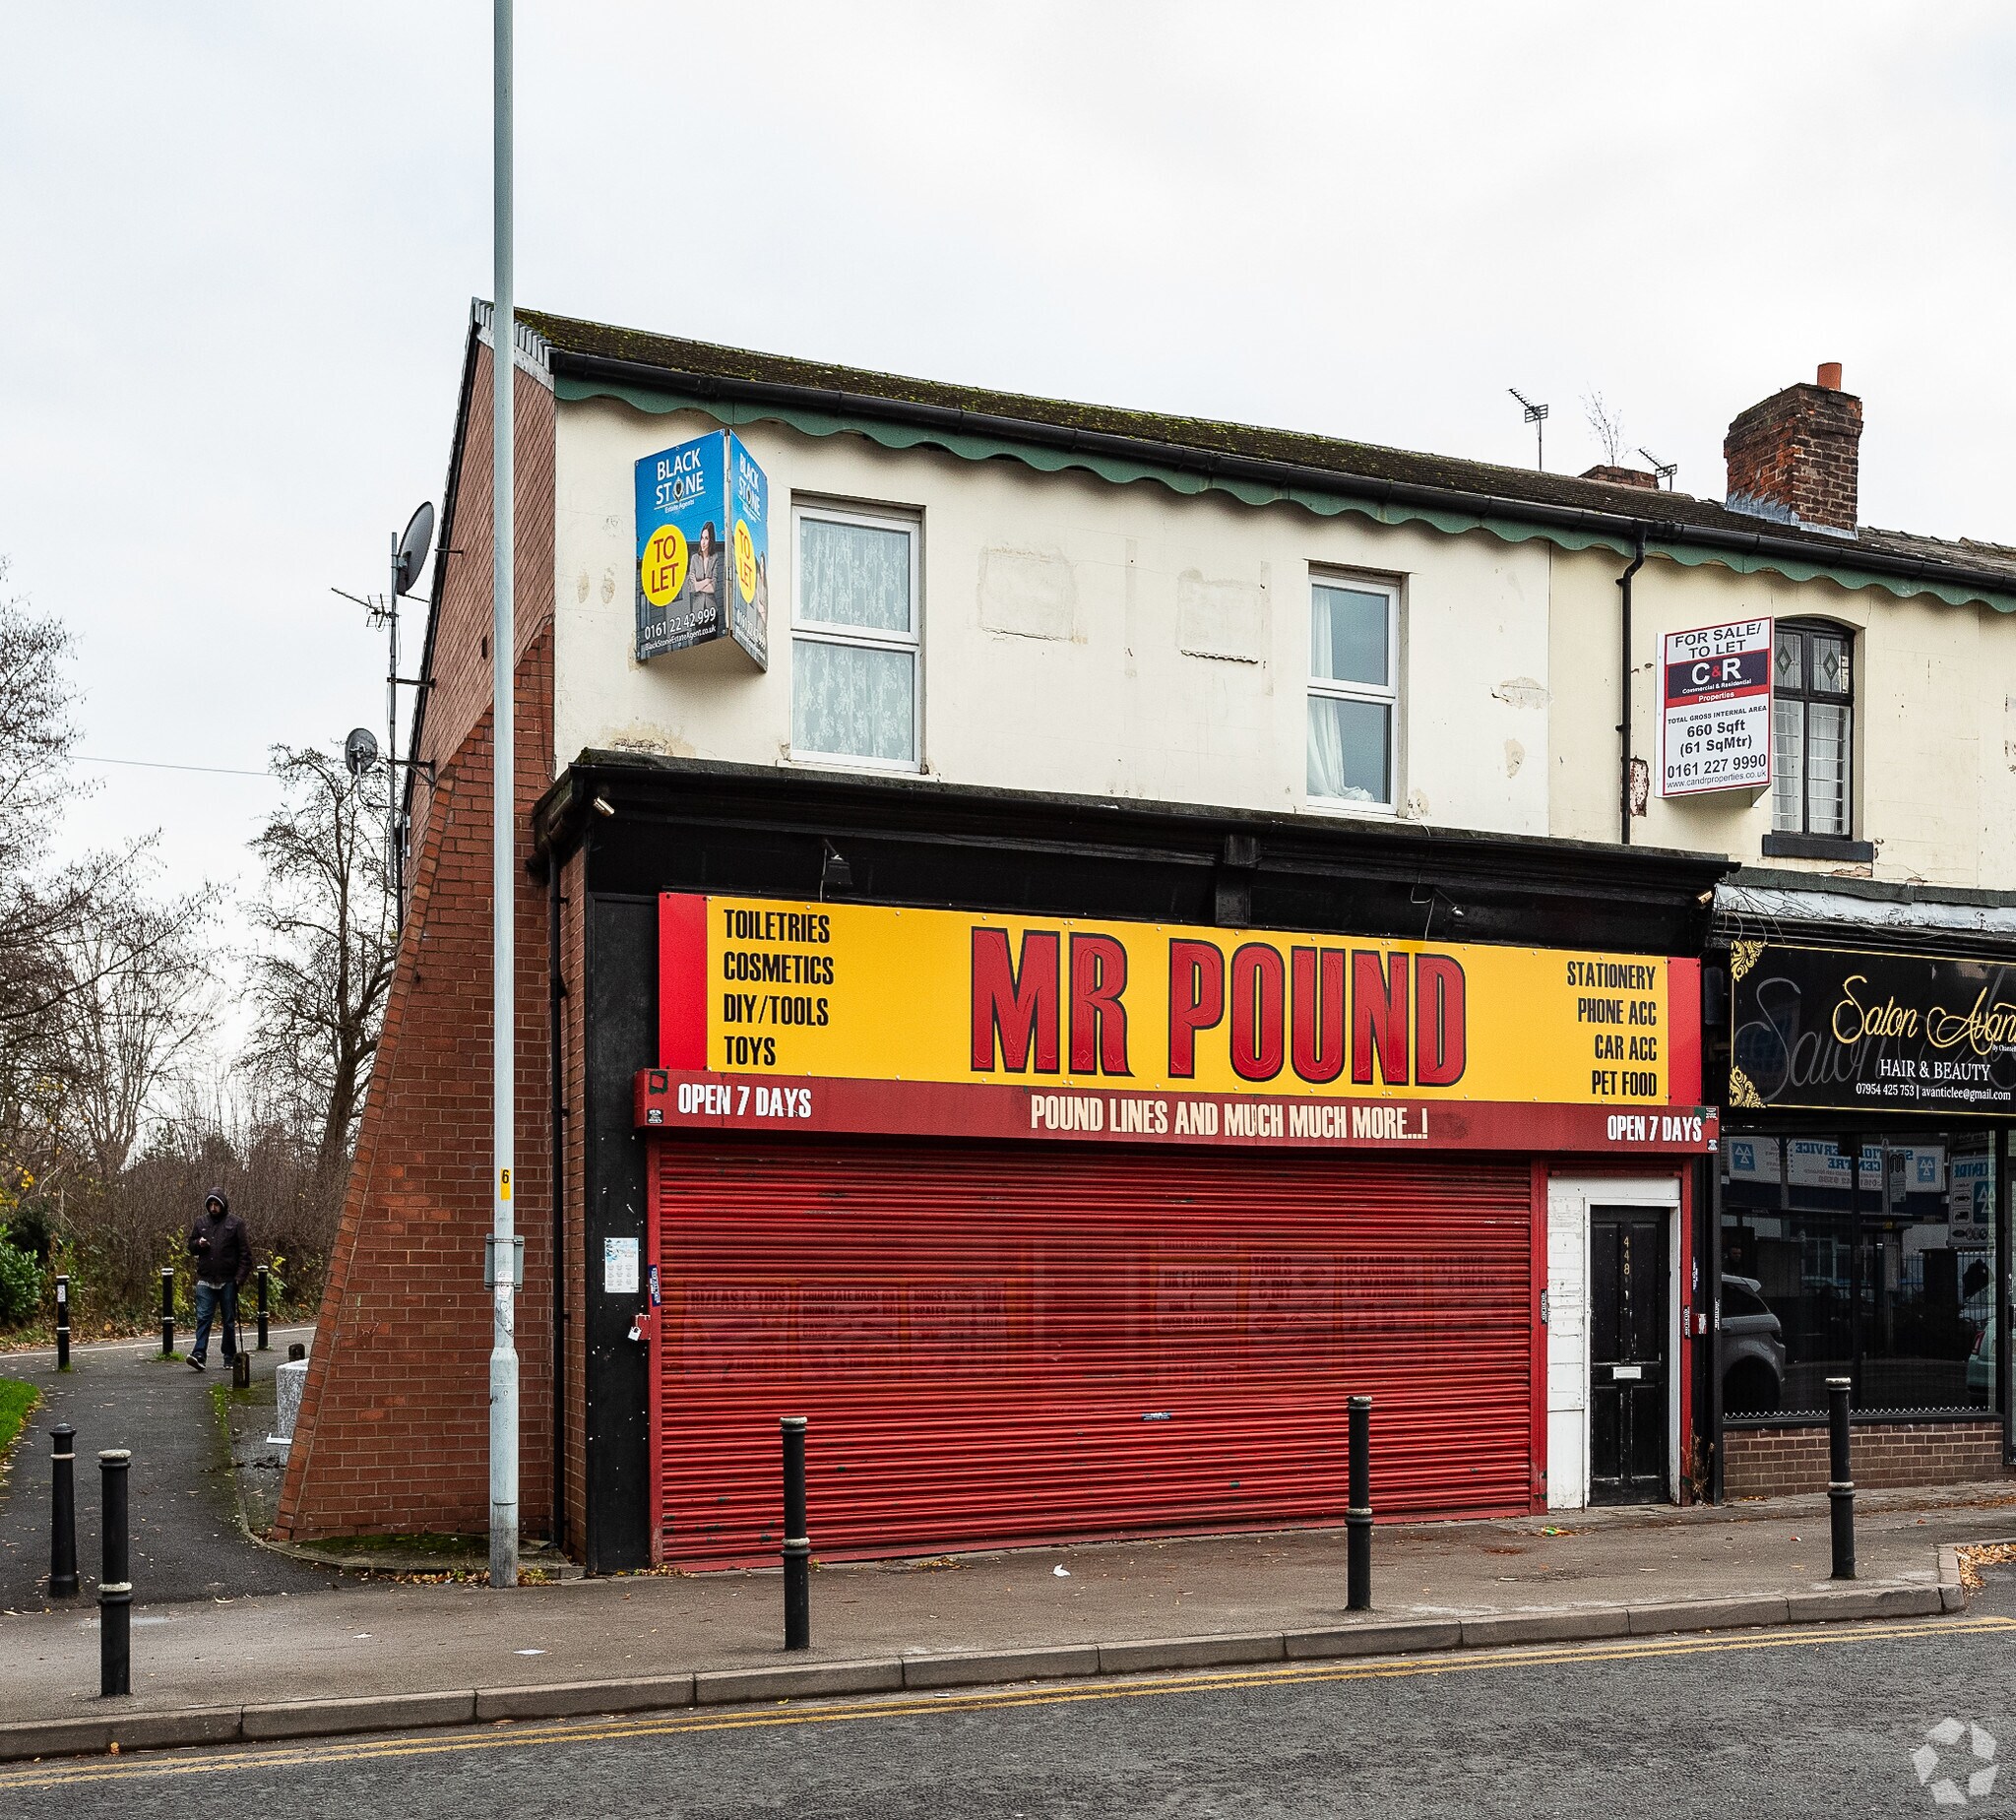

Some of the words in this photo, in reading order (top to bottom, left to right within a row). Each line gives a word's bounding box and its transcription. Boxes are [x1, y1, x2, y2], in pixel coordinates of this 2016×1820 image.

[657, 447, 702, 481] BLACK
[654, 534, 676, 563] TO
[651, 562, 679, 595] LET
[644, 620, 667, 641] 0161
[669, 616, 682, 633] 22
[683, 612, 696, 629] 42
[697, 606, 717, 625] 999
[1674, 632, 1708, 649] FOR
[1713, 622, 1761, 642] SALE/
[1688, 645, 1711, 659] TO
[1716, 639, 1746, 656] LET
[1681, 683, 1715, 694] Commercial
[1721, 678, 1752, 688] Residential
[1698, 691, 1735, 703] Properties
[1668, 716, 1688, 725] TOTAL
[1689, 713, 1712, 722] GROSS
[1713, 708, 1747, 719] INTERNAL
[1748, 705, 1767, 714] AREA
[1686, 723, 1713, 738] 660
[1716, 719, 1745, 734] Sqft
[1679, 740, 1700, 758] (61
[1706, 734, 1752, 753] SqMtr)
[1667, 769, 1767, 788] www.candrproperties.co.uk
[1668, 761, 1698, 779] 0161
[1704, 758, 1729, 775] 227
[1732, 753, 1766, 771] 9990
[724, 909, 831, 944] TOILETRIES
[724, 951, 834, 985] COSMETICS
[1566, 960, 1656, 990] STATIONERY
[724, 992, 829, 1027] DIY/TOOLS
[970, 925, 1136, 1079] MR
[1167, 936, 1468, 1088] POUND
[1577, 997, 1624, 1025] PHONE
[1628, 1000, 1657, 1027] ACC
[1832, 974, 1919, 1044] Salon
[724, 1036, 777, 1066] TOYS
[1594, 1034, 1624, 1061] CAR
[1628, 1036, 1658, 1062] ACC
[1591, 1070, 1618, 1096] PET
[1621, 1071, 1657, 1098] FOOD
[1879, 1059, 1916, 1078] HAIR
[1919, 1060, 1930, 1079] &
[1933, 1061, 1991, 1081] BEAUTY
[677, 1083, 731, 1115] OPEN
[736, 1085, 751, 1116] 7
[755, 1086, 812, 1118] DAYS
[1856, 1082, 1881, 1096] 07954
[1882, 1084, 1899, 1097] 425
[1899, 1084, 1915, 1097] 753
[1922, 1086, 2011, 1102] avanticlee@gmail.com
[1031, 1094, 1103, 1132] POUND
[1109, 1098, 1168, 1134] LINES
[1174, 1100, 1219, 1136] AND
[1224, 1102, 1284, 1138] MUCH
[1289, 1104, 1348, 1139] MUCH
[1606, 1114, 1646, 1142] OPEN
[1649, 1115, 1659, 1142] 7
[1662, 1116, 1702, 1143] DAYS
[501, 1168, 510, 1184] 6
